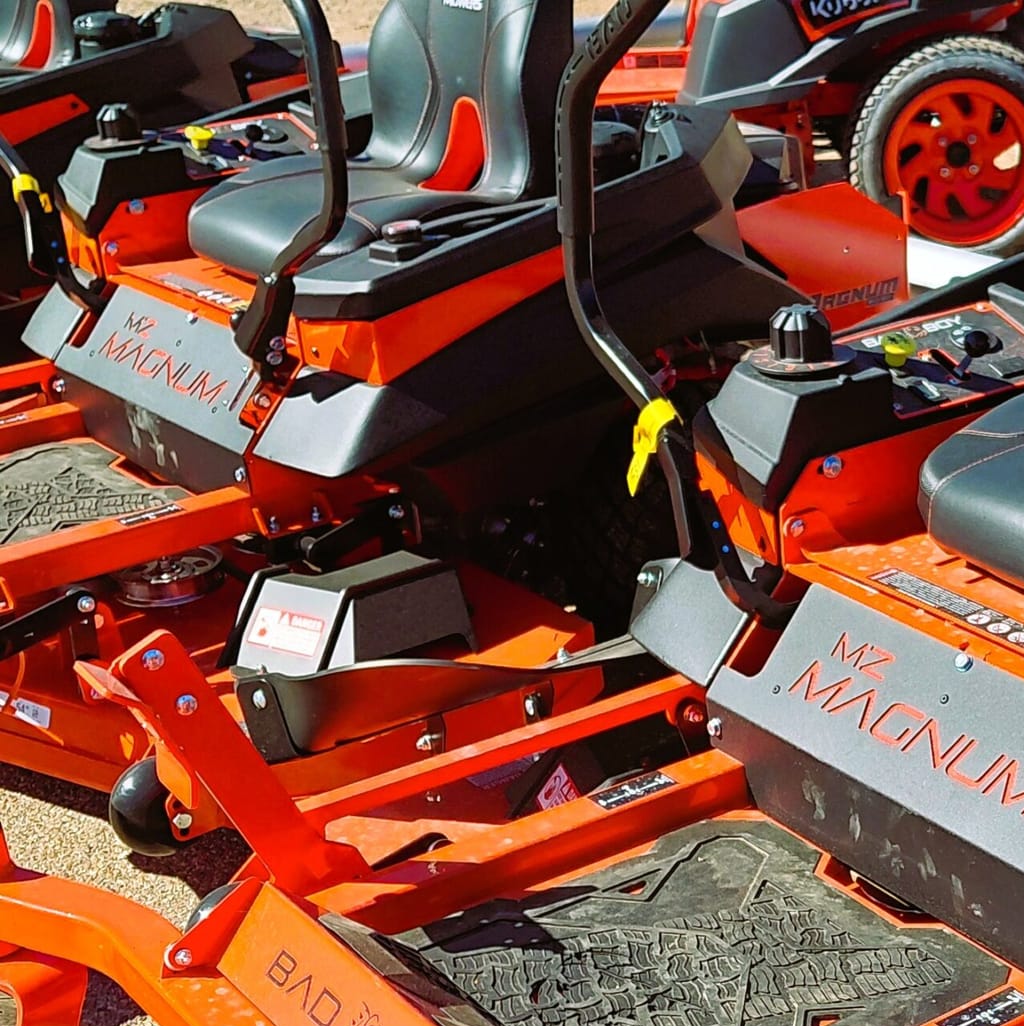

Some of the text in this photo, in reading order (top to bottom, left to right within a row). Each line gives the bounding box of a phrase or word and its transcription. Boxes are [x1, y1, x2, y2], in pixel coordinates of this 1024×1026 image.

[123, 311, 158, 340] MZ
[98, 330, 229, 405] MAGNUM
[830, 631, 897, 683] MZ
